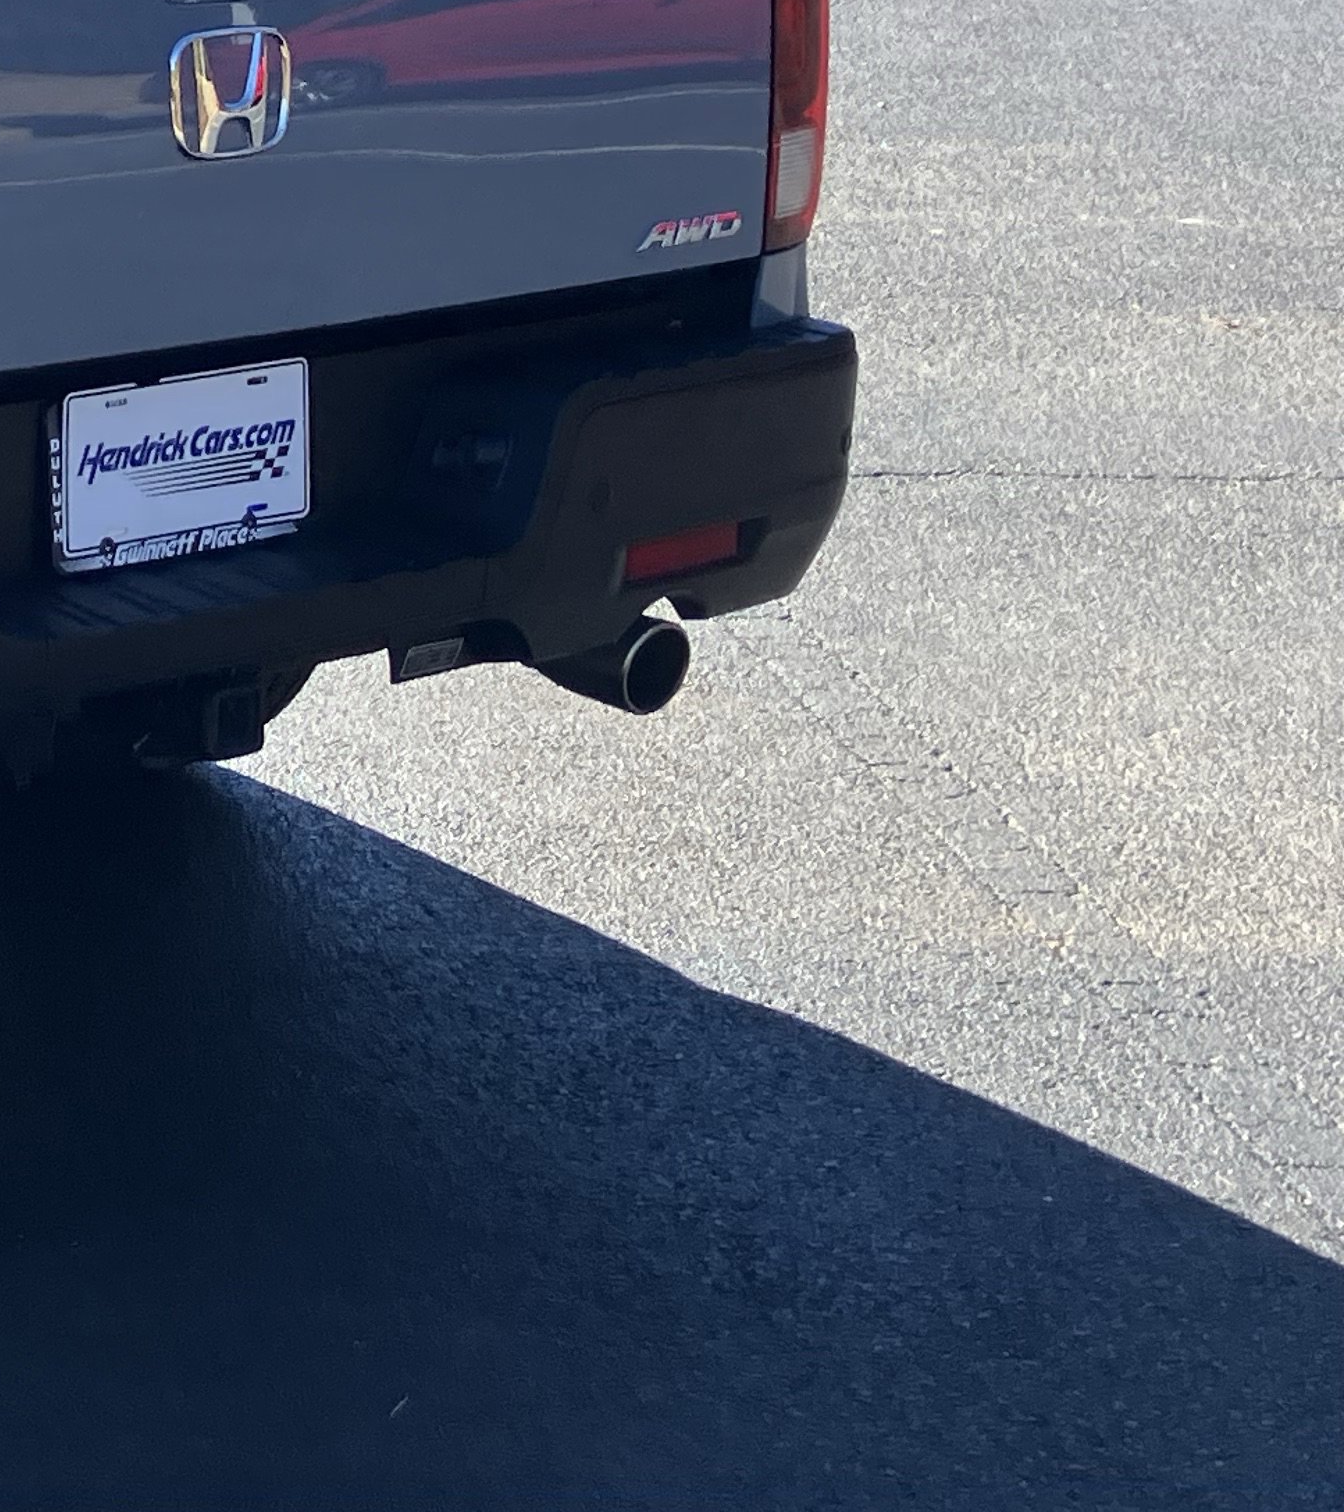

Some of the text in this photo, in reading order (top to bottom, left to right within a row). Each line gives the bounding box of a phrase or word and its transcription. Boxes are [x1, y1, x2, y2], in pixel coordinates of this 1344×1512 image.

[635, 210, 742, 253] AWD
[49, 437, 63, 543] DULUTH
[114, 525, 249, 565] Gwinnett Place
